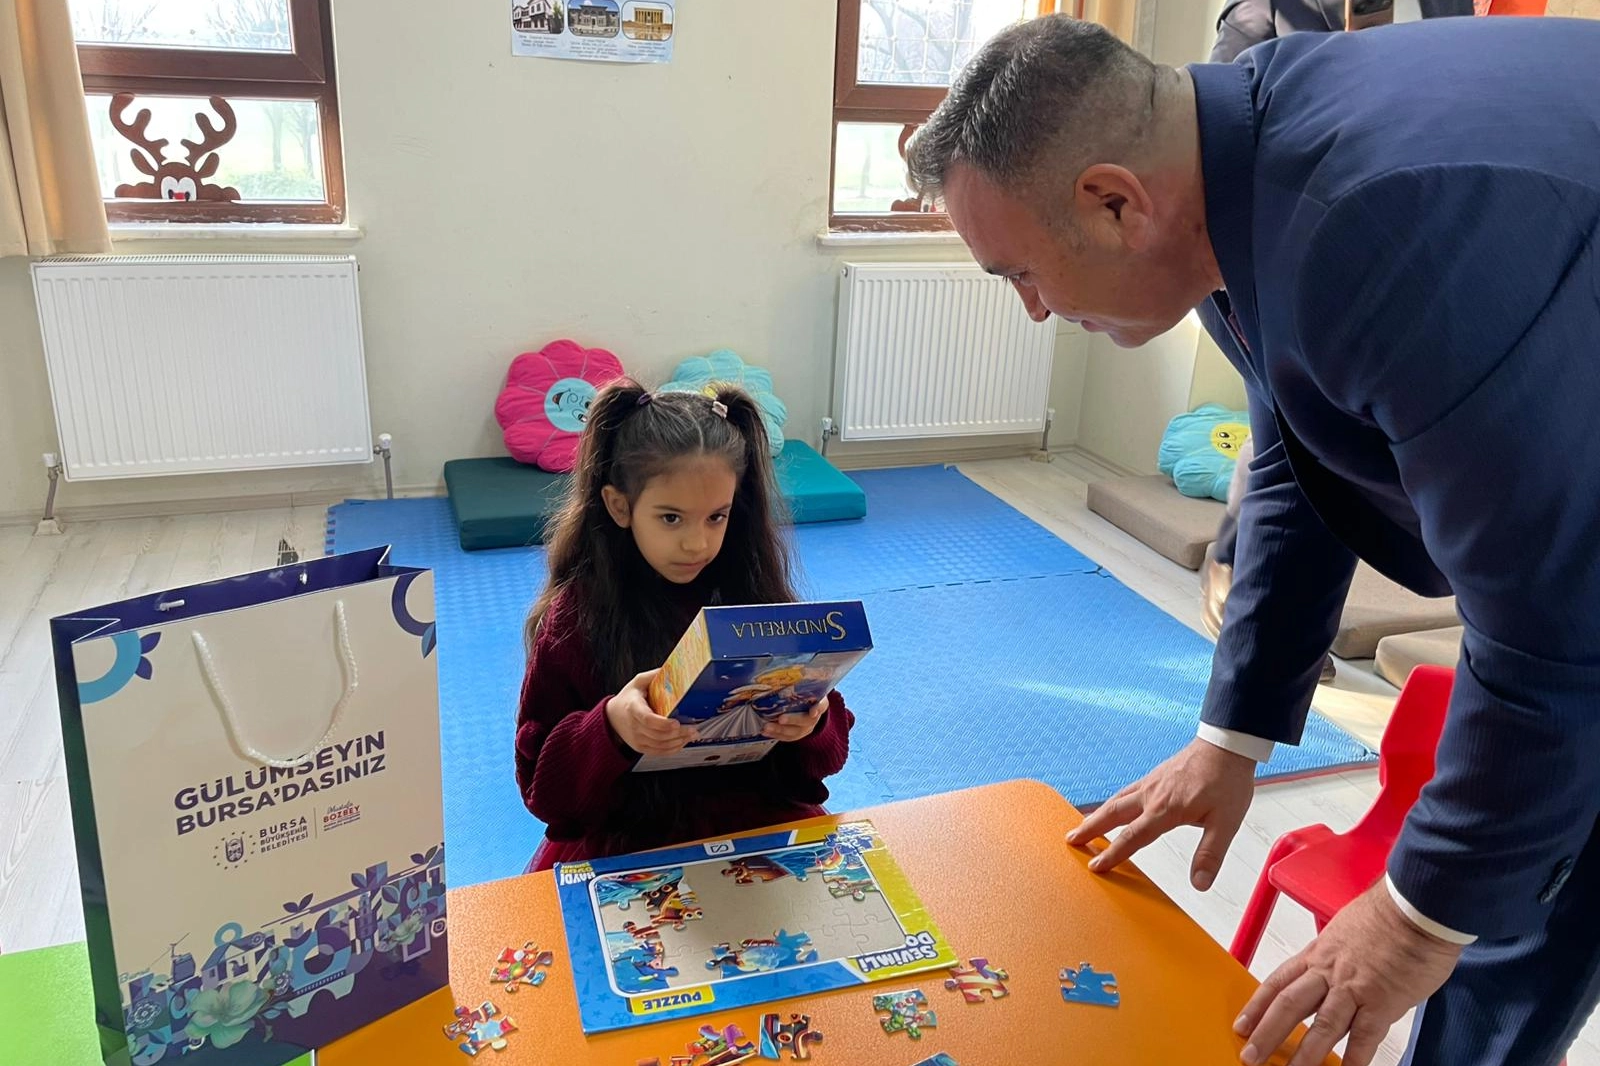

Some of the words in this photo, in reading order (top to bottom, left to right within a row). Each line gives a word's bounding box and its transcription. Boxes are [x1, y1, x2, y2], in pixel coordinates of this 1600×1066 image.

[732, 611, 847, 641] SINDYRELLA
[174, 731, 385, 811] GÜLÜMSEYİN
[176, 754, 386, 836] BURSA'DASINIZ
[323, 805, 361, 823] BOZBEY
[259, 816, 308, 838] BURSA
[260, 825, 309, 846] BÜYÜKŞEHİR
[260, 831, 309, 854] BELEDİYESİ
[643, 992, 702, 1010] PUZZLE
